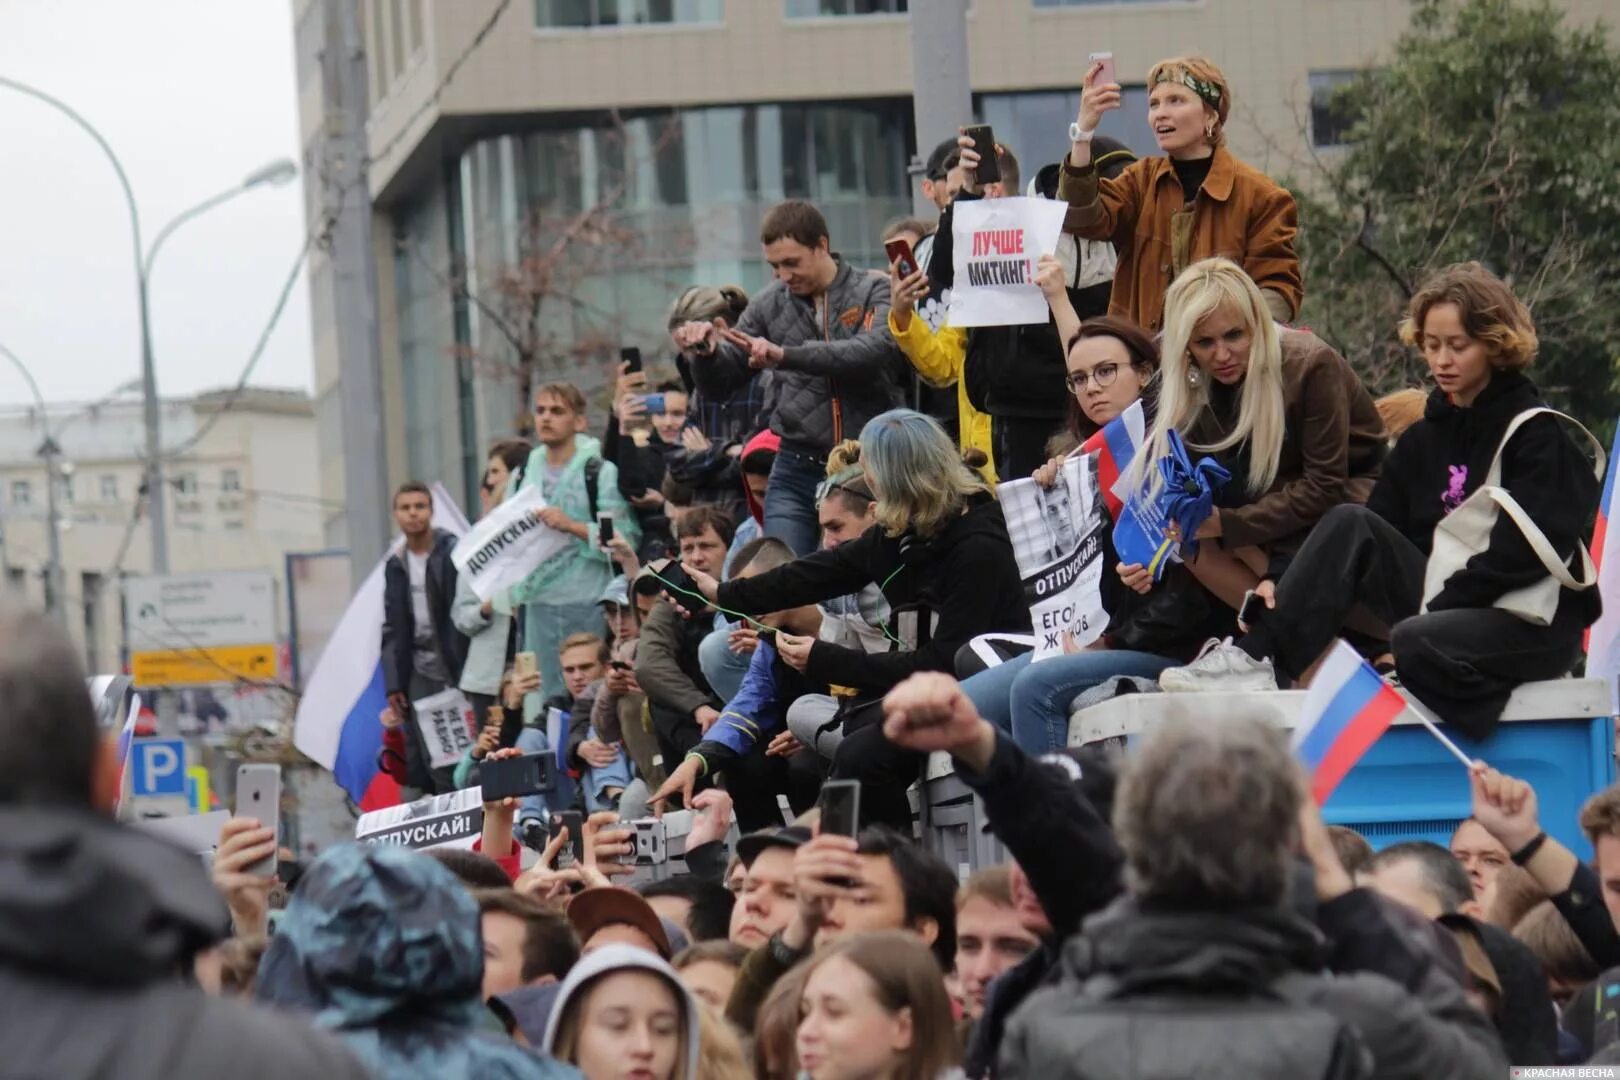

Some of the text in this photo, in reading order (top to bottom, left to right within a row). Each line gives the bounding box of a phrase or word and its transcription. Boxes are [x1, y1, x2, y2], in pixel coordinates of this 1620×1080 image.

[972, 229, 1024, 256] ЛУЧШЕ
[967, 259, 1032, 286] МИТИНГ!
[1035, 536, 1098, 595] ОТПУСКАЙ!
[1043, 614, 1089, 650] ЖКОВ
[142, 744, 179, 792] P
